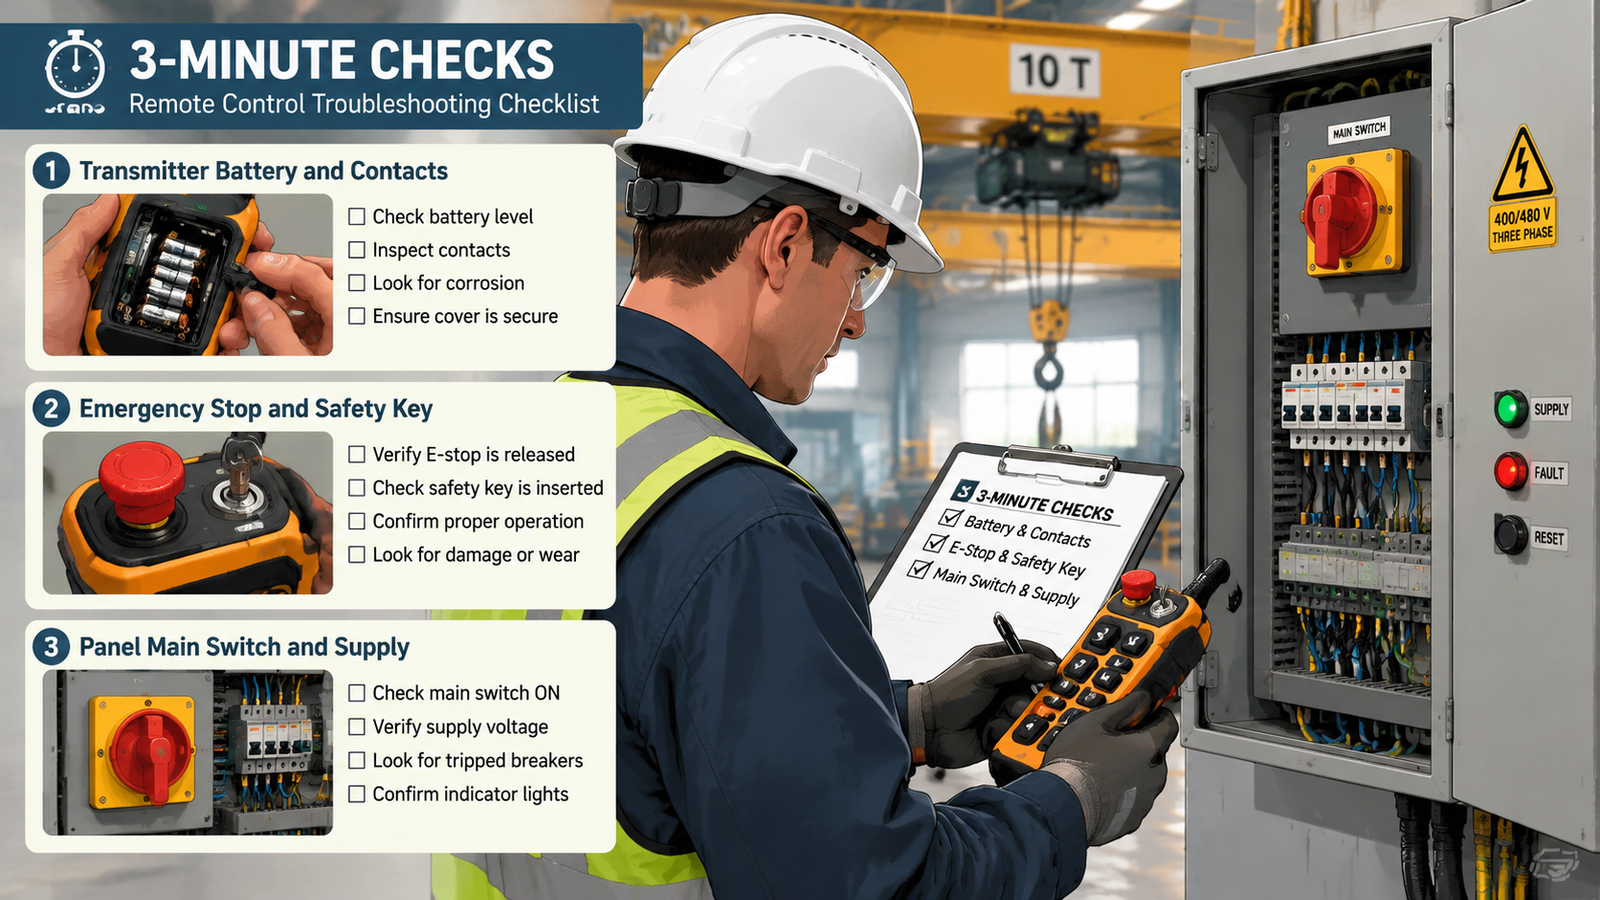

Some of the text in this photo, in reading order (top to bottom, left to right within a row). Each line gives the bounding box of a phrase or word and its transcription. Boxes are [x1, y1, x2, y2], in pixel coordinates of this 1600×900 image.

[1019, 53, 1091, 90] 10 T
[1332, 121, 1387, 140] MAIN SWITCH
[1494, 206, 1551, 227] 400/480 V
[1492, 226, 1554, 244] THREE PHASE
[1534, 402, 1570, 416] SUPPLY
[1534, 465, 1565, 480] FAULT
[976, 489, 1050, 512] 3-MINUTE
[1050, 500, 1114, 522] CHECKS
[964, 515, 1092, 549] Battery & Contacts
[1534, 530, 1565, 546] RESET
[949, 540, 1086, 581] E-Stop & Safety Key
[932, 567, 1080, 610] Main Switch & Supply
